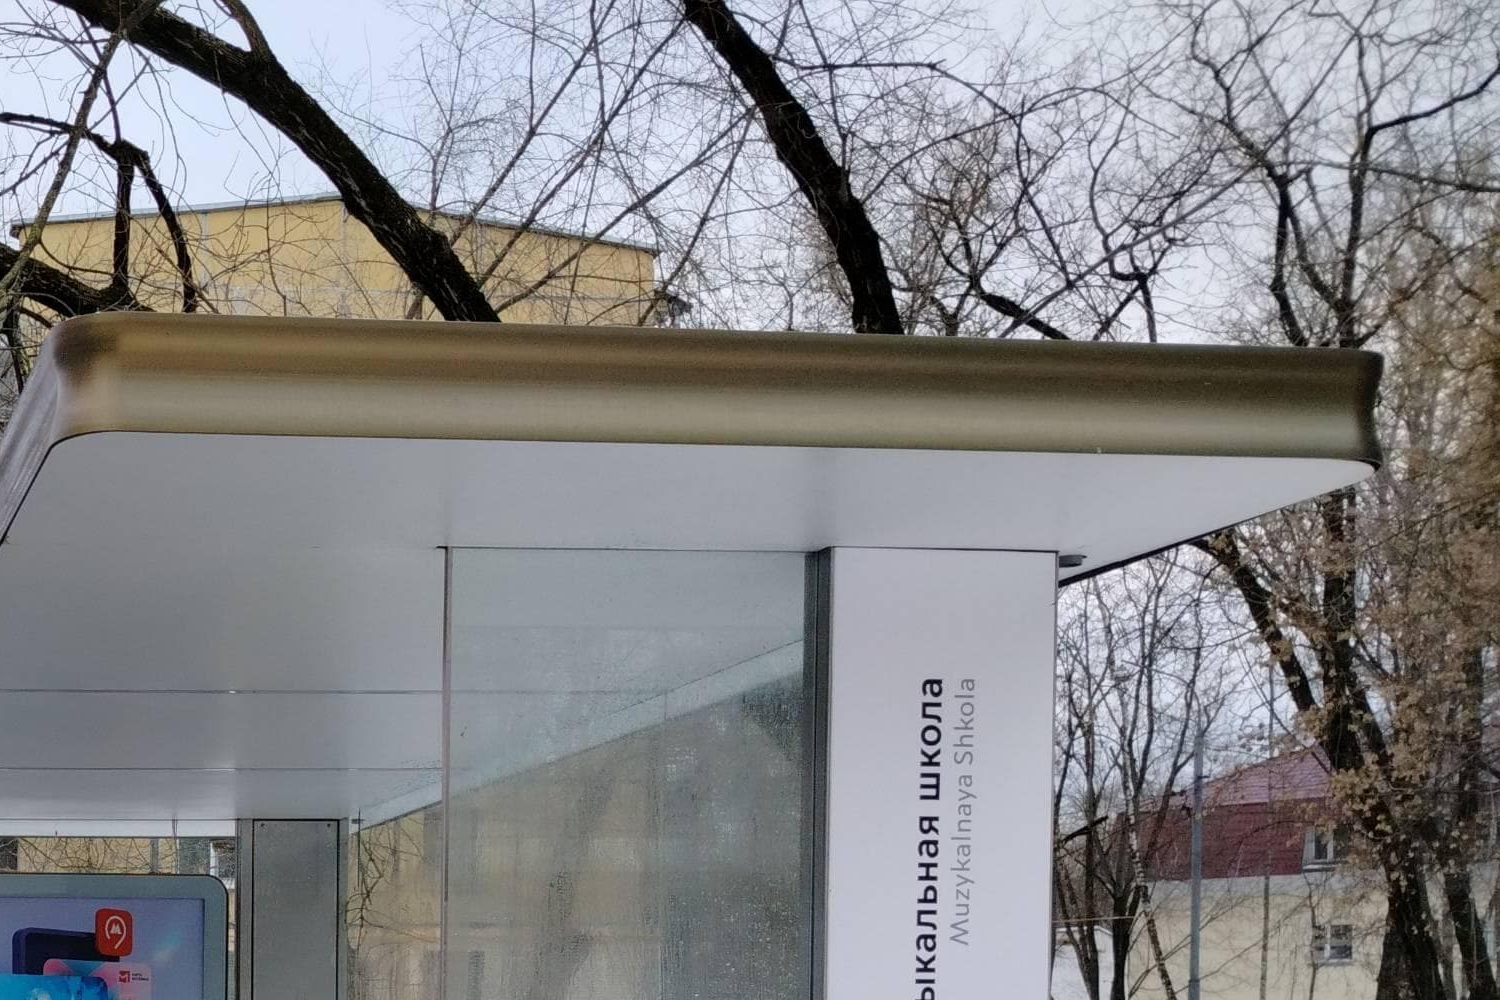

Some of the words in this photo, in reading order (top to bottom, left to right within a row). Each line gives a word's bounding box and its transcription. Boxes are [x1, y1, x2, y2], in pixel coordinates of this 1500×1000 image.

[918, 676, 943, 802] школа
[953, 676, 976, 766] Shkola
[950, 774, 978, 946] Muzykalnaya
